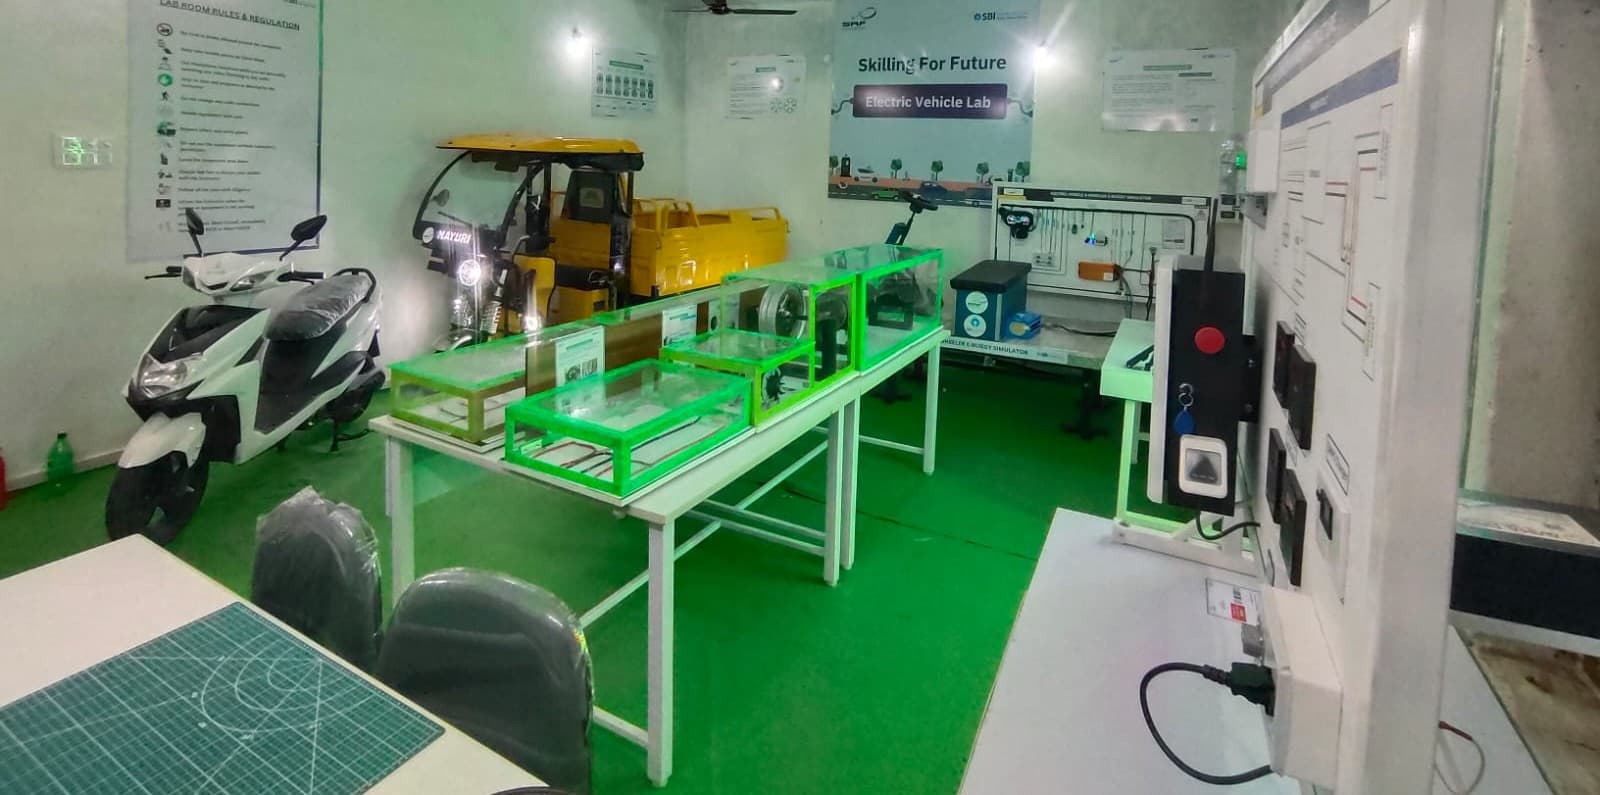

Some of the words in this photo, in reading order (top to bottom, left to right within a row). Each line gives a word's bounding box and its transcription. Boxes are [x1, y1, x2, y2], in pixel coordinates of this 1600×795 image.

[160, 0, 179, 8] LAB
[181, 2, 210, 15] ROOM
[211, 8, 240, 19] RULES
[249, 14, 300, 31] REGULATION
[982, 12, 996, 21] SBI
[858, 57, 915, 74] Skilling
[919, 57, 946, 71] For
[950, 56, 1007, 71] Future
[865, 96, 912, 109] Electric
[914, 96, 963, 109] Vehicle
[966, 96, 991, 109] Lab
[993, 345, 1029, 355] SIMULATOR
